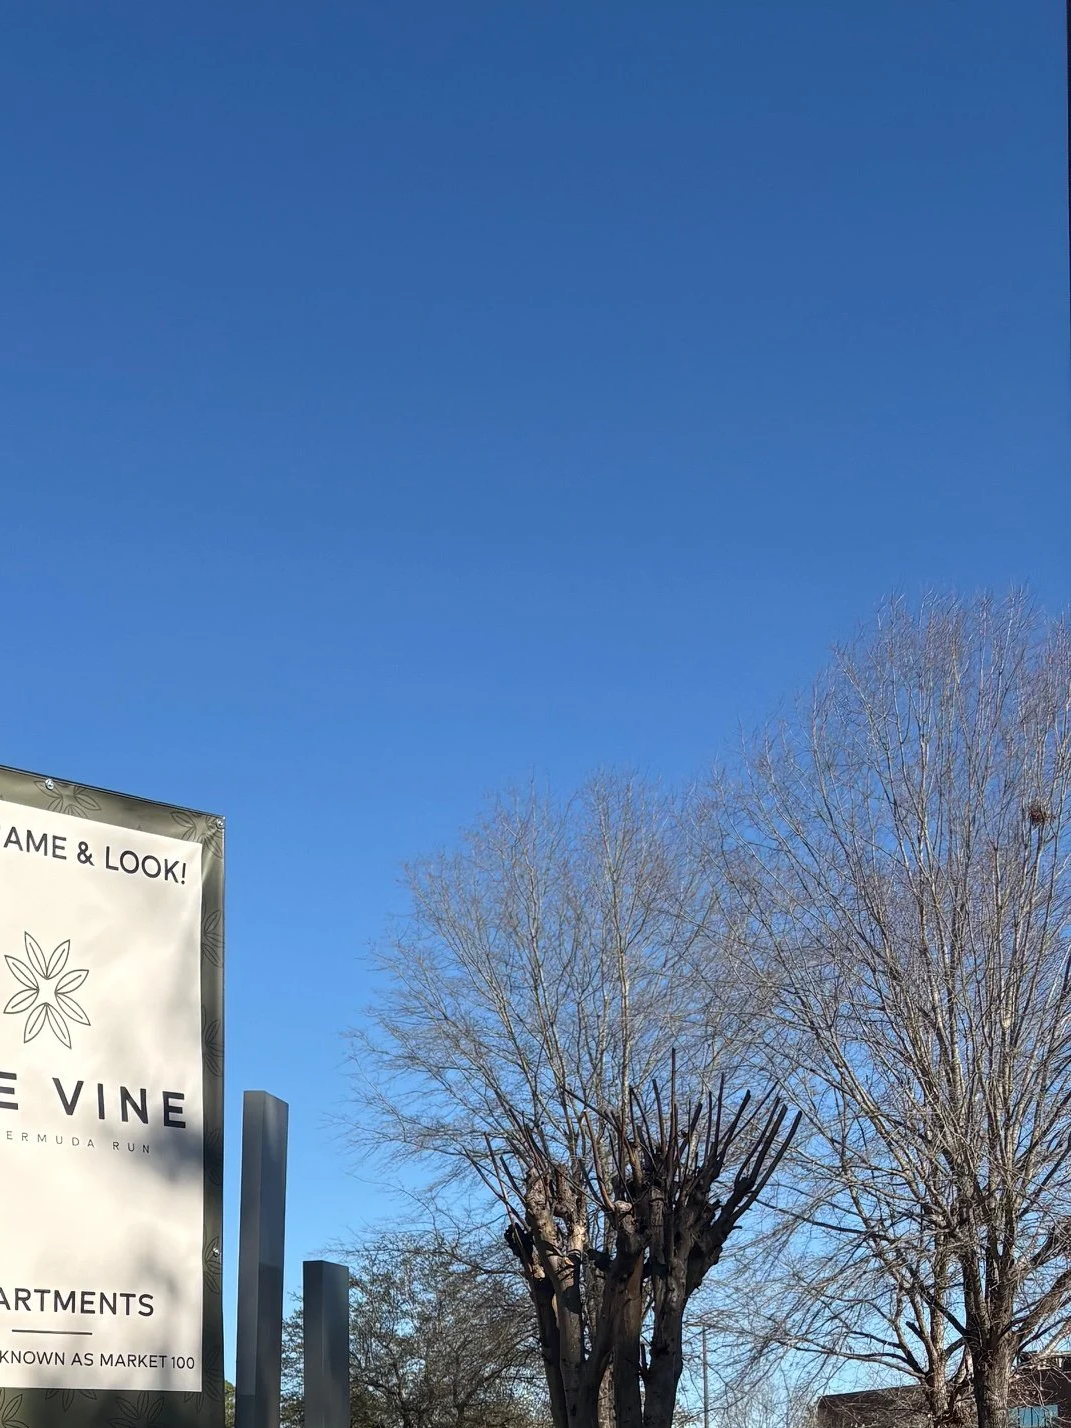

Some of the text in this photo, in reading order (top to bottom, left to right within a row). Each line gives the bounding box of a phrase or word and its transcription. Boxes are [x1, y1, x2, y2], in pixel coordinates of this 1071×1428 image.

[76, 840, 96, 867] &
[105, 846, 187, 885] LOOK!
[52, 1077, 187, 1129] VINE
[112, 1141, 152, 1155] RUN
[0, 1349, 66, 1367] KNOWN
[71, 1351, 95, 1367] AS
[100, 1353, 168, 1370] MARKET
[171, 1356, 196, 1370] 100
